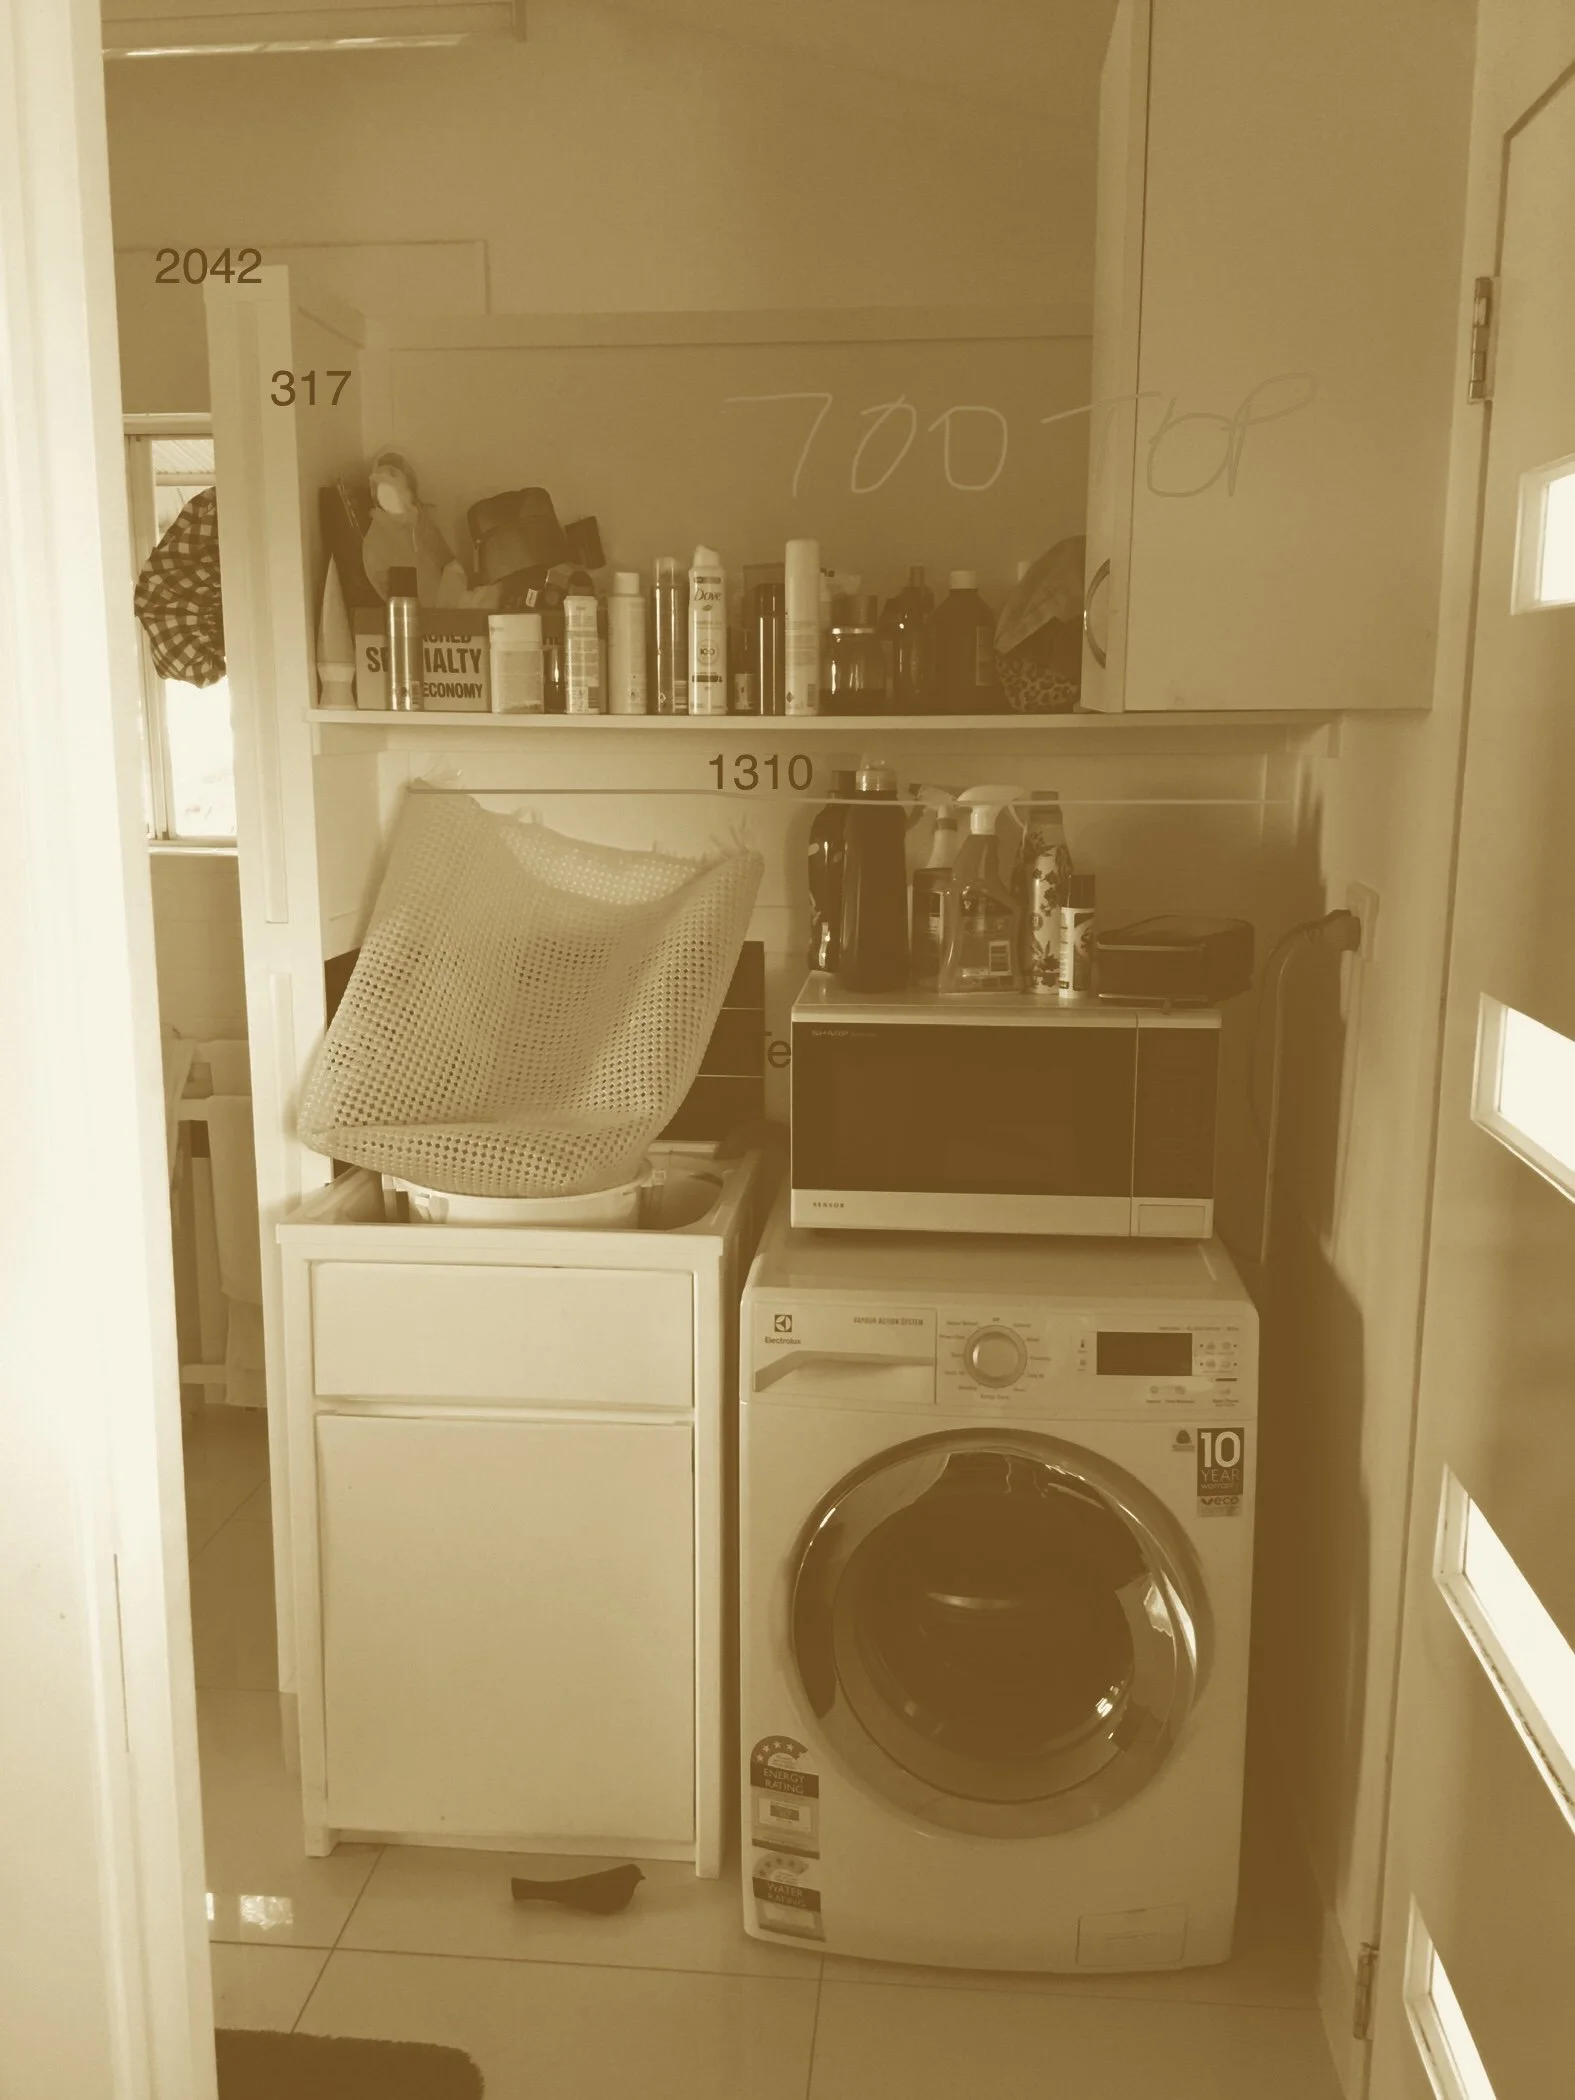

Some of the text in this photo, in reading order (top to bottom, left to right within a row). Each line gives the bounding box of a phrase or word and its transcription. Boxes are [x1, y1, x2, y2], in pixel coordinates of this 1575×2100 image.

[694, 588, 722, 601] Dove
[366, 645, 482, 674] SPIALTY
[423, 681, 483, 699] ECONOMY
[764, 1336, 802, 1345] Electrolux
[1201, 1431, 1241, 1467] 10
[1201, 1468, 1241, 1483] YEAR
[763, 1767, 805, 1784] ENERGY
[764, 1778, 805, 1795] RATING
